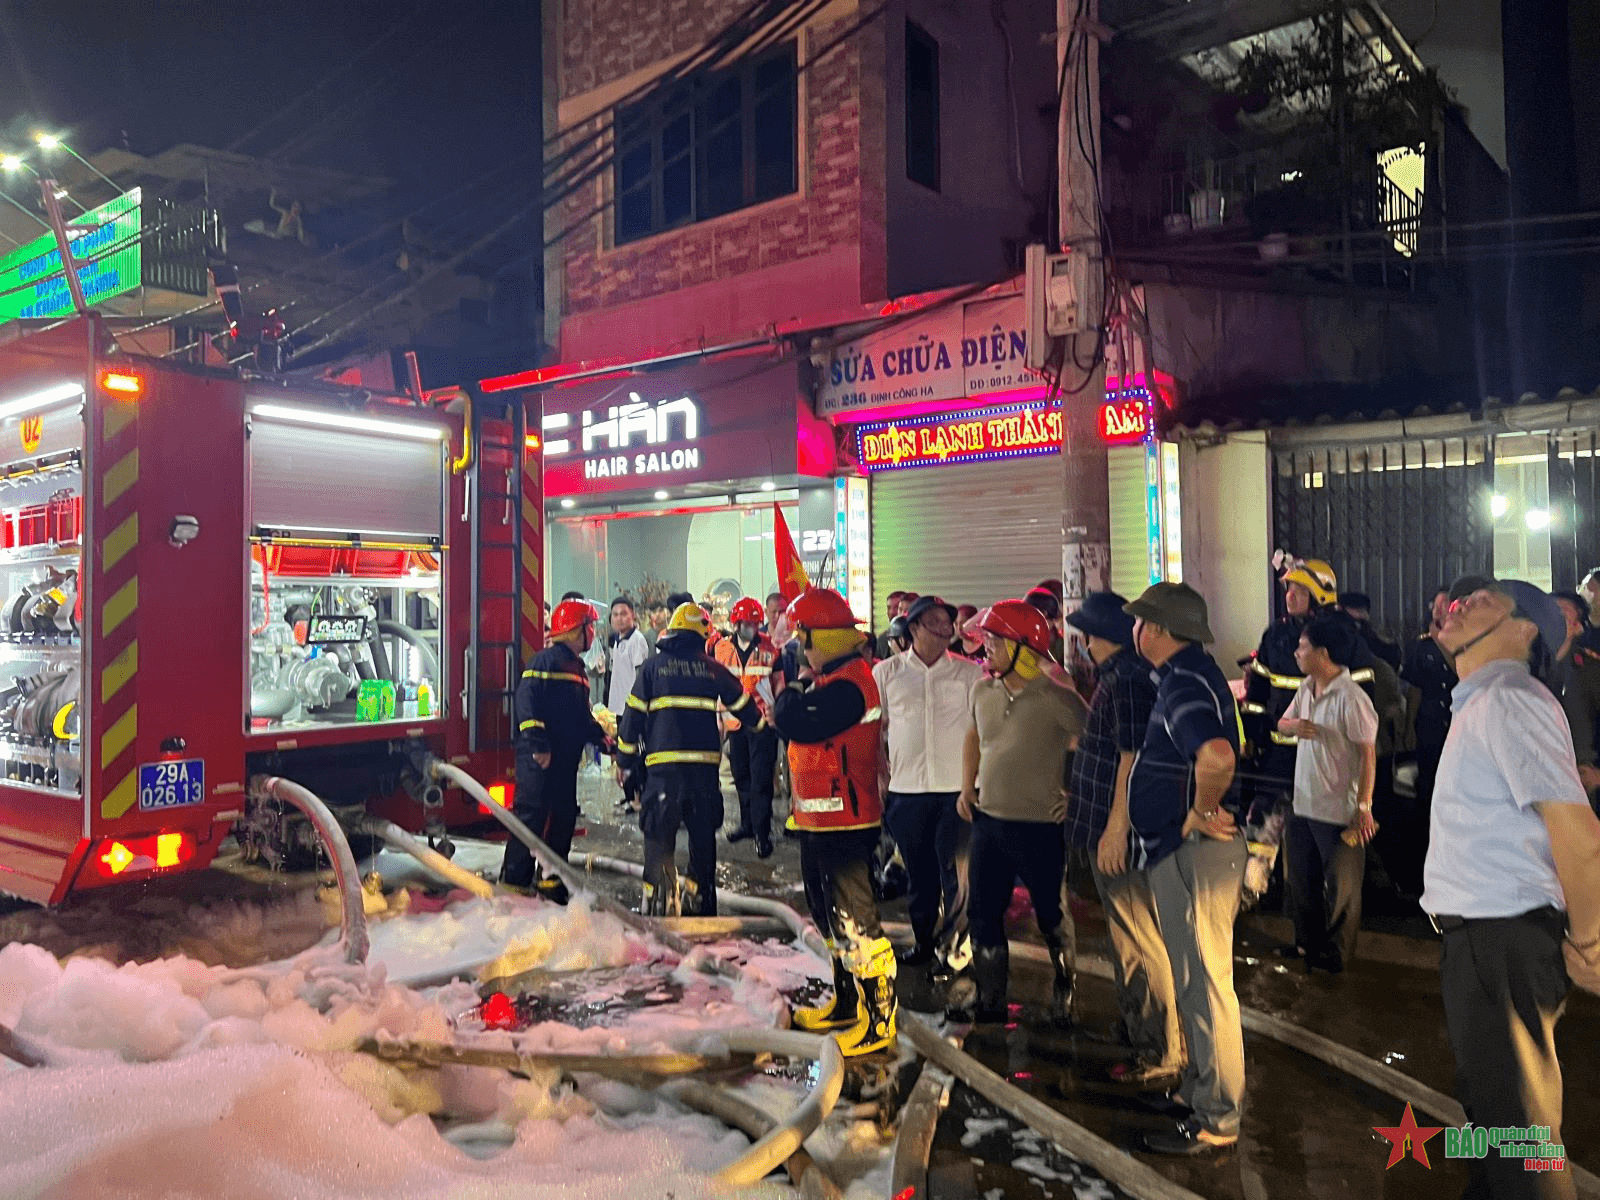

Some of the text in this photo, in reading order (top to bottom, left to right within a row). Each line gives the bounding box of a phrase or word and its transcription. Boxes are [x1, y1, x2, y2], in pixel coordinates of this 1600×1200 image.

[831, 324, 1026, 386] SỬA CHỮA ĐIỆN
[920, 421, 984, 460] LẠNH
[584, 447, 698, 479] HAIR SALON
[155, 762, 189, 785] 29A
[142, 781, 202, 808] 026.13
